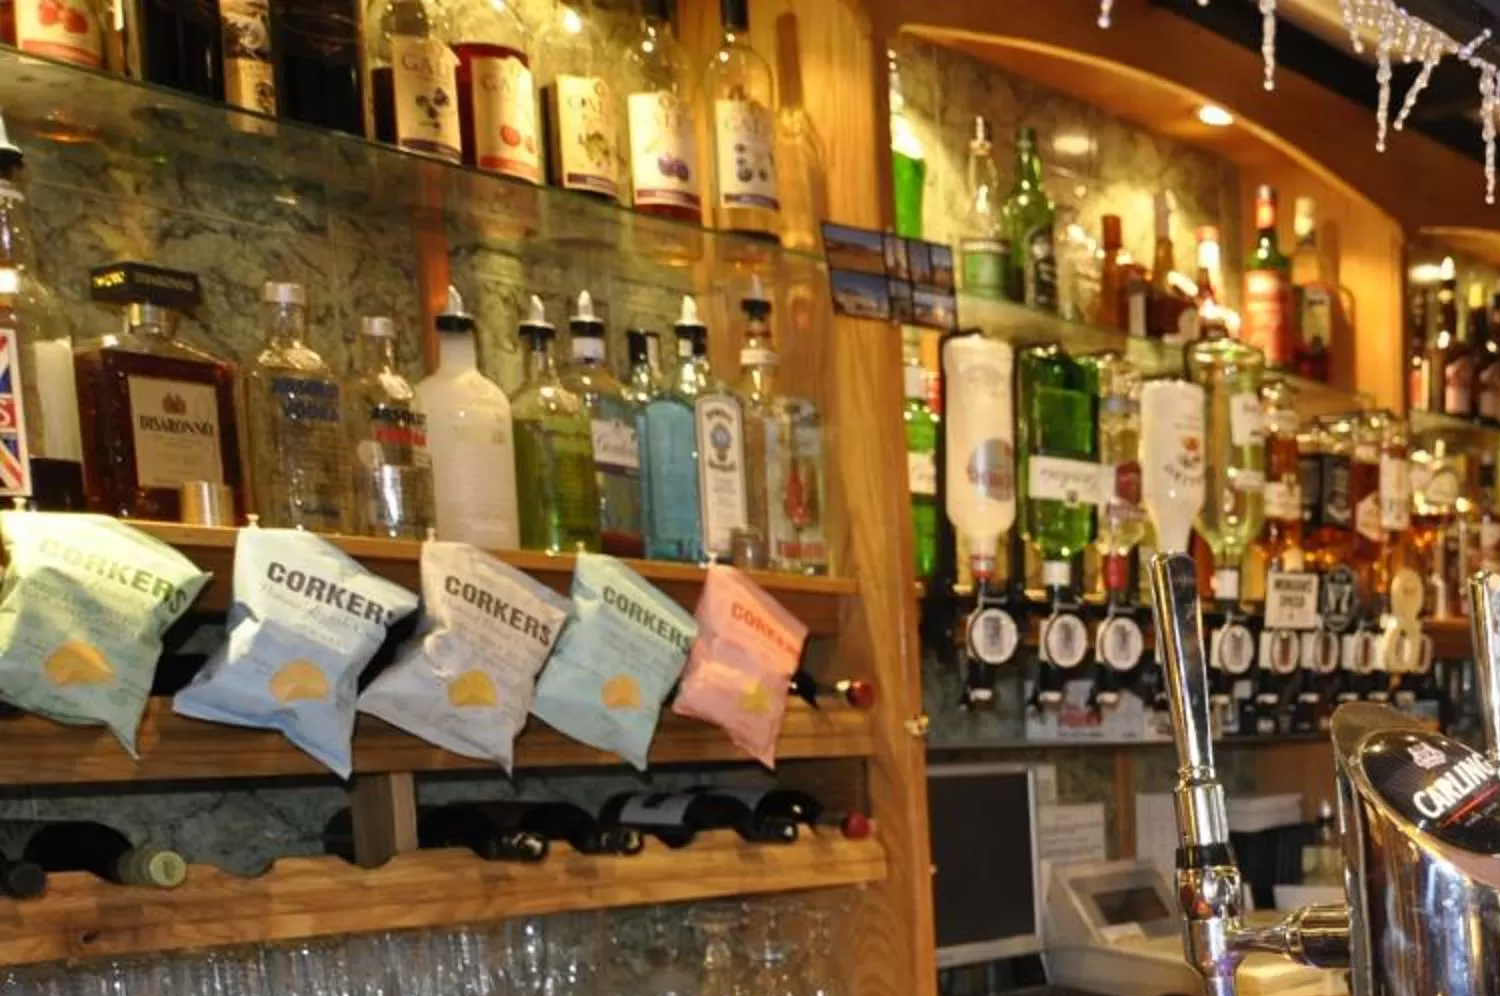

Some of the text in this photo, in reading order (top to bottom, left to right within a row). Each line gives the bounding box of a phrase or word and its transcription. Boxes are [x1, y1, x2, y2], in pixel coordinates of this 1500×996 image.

[139, 414, 214, 438] DISARONNO
[38, 538, 188, 614] CORKERS
[443, 574, 552, 648] CORKERS
[602, 584, 691, 652] CORKERS
[730, 600, 799, 655] CORK
[1413, 751, 1497, 819] CARLING
